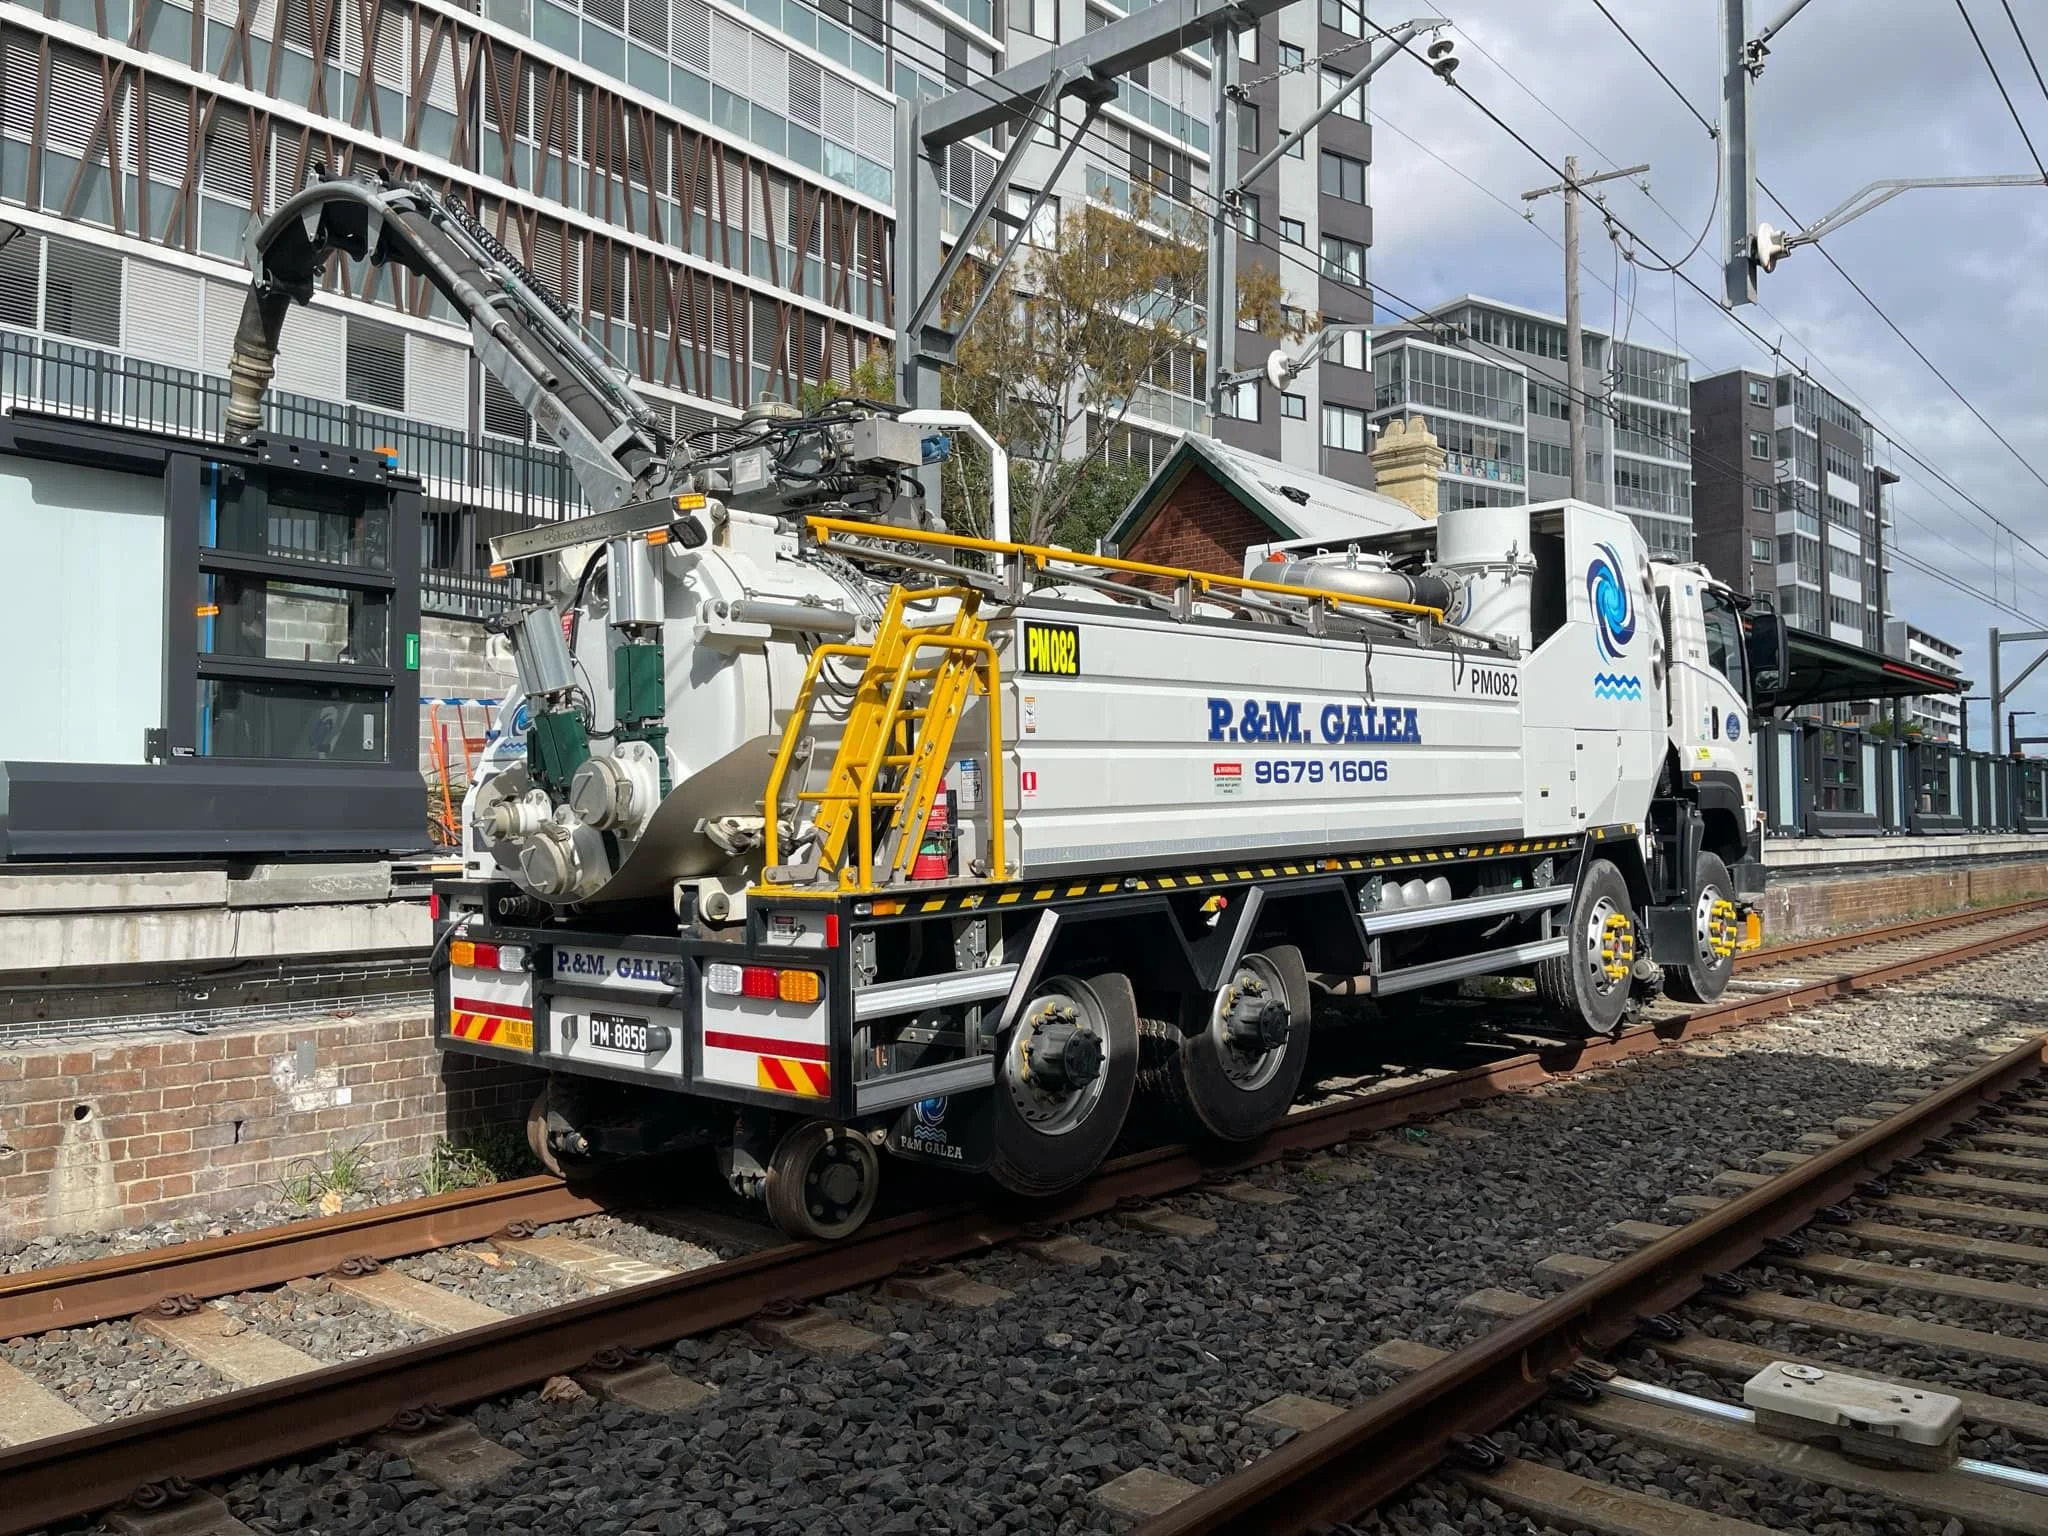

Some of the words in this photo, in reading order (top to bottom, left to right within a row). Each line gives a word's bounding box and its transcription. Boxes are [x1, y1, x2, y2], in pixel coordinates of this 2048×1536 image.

[1027, 625, 1078, 676] PM082
[1470, 667, 1519, 698] PM082
[1207, 697, 1312, 745] P.&M.
[1320, 703, 1422, 745] GALEA
[1254, 760, 1324, 784] 9679
[1328, 760, 1389, 783] 1606
[557, 950, 611, 977] P.&M.
[901, 1135, 922, 1152] P&M
[924, 1141, 964, 1160] GALEA
